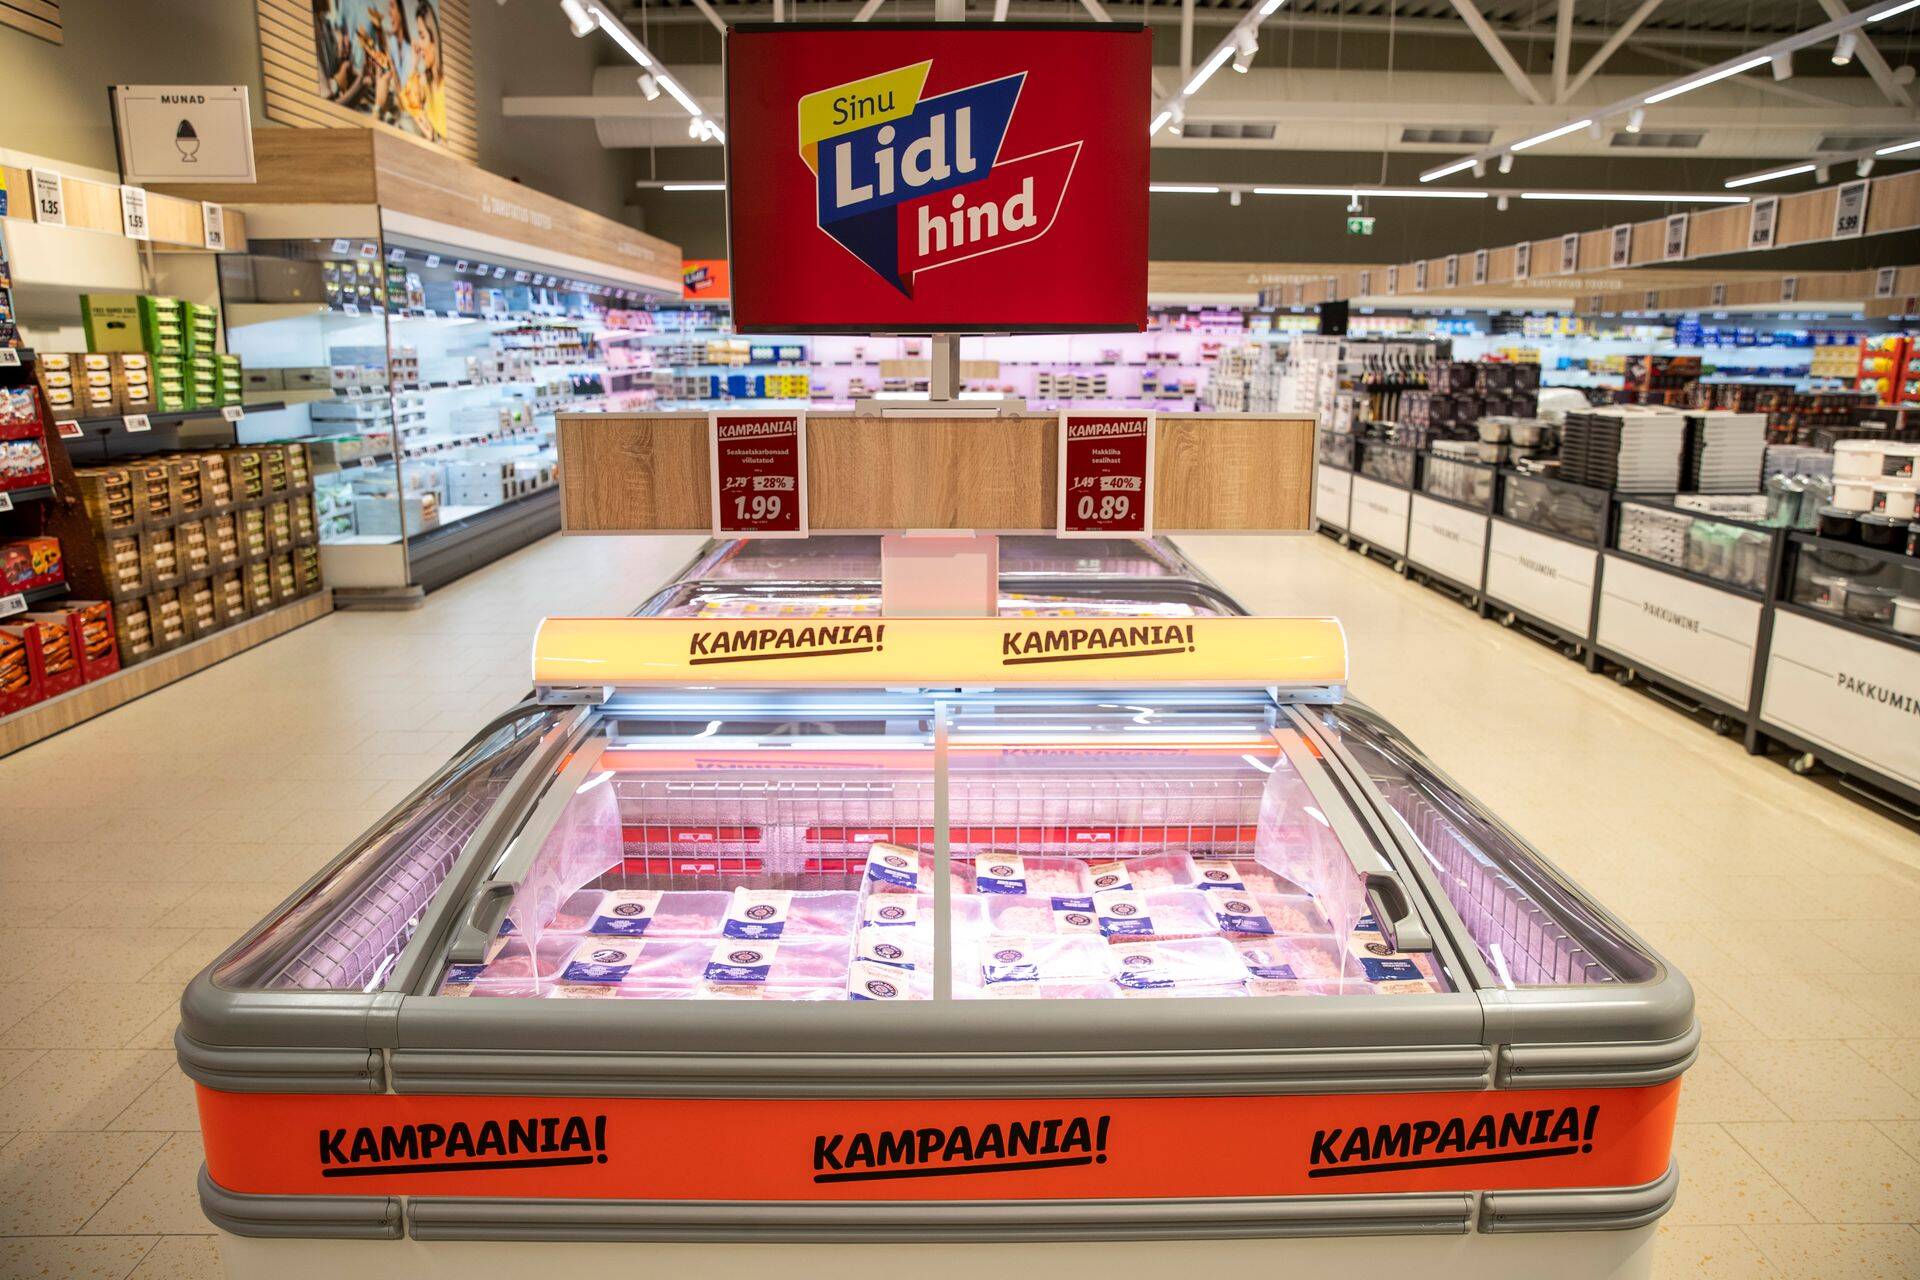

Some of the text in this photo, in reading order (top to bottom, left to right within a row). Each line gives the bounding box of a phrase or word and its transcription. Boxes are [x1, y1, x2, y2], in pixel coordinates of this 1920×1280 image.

[161, 95, 206, 105] MUNAD
[832, 90, 896, 126] Sinu
[835, 106, 977, 208] Lidl
[41, 199, 58, 214] 1.35
[918, 176, 1037, 257] hind
[718, 420, 798, 438] KAMPAANIA!
[1068, 420, 1147, 438] KAMPAANIA!
[726, 477, 787, 489] 2.79 -28%
[1073, 476, 1134, 489] 1.49 -40%
[734, 495, 782, 520] 1.99
[1077, 495, 1130, 520] 0.89
[1643, 601, 1699, 633] PAKKUMINE
[690, 624, 885, 655] KAMPAANIA!
[1003, 624, 1196, 655] KAMPAANIA!
[319, 1114, 608, 1165] KAMPAANIA!
[813, 1114, 1111, 1170] KAMPAANIA!
[1310, 1104, 1600, 1165] KAMPAANIA!
